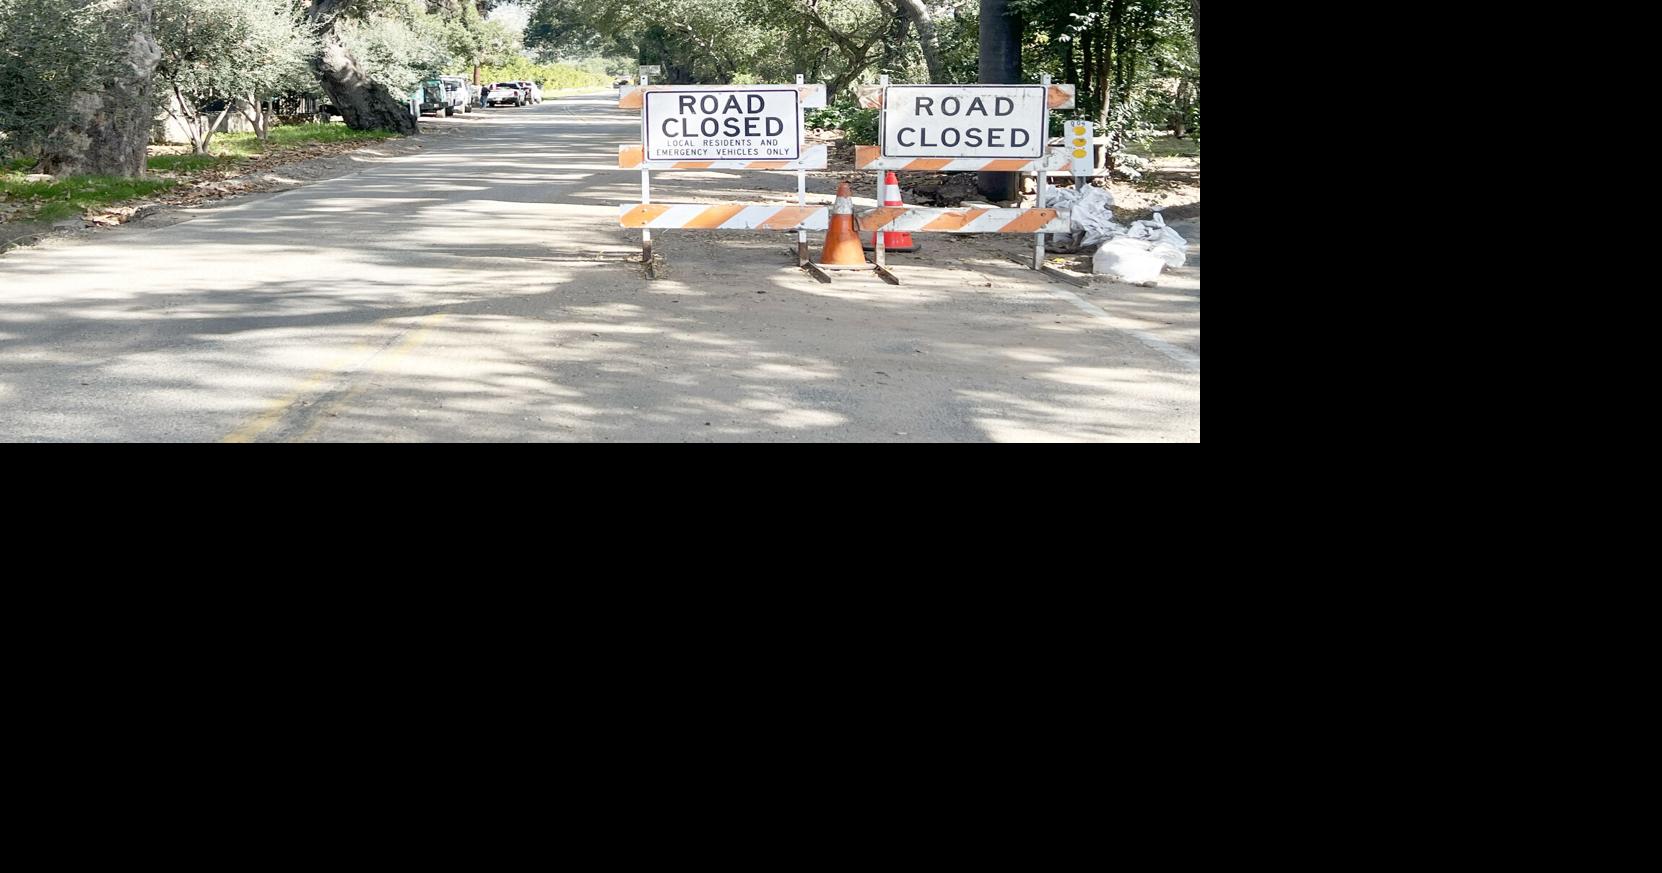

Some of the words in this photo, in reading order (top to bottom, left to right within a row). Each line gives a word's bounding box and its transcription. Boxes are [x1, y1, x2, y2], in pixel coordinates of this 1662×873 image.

[678, 94, 766, 115] ROAD
[914, 96, 1015, 117] ROAD
[661, 116, 784, 138] CLOSED
[896, 127, 1030, 148] CLOSED
[656, 148, 708, 156] EMERGENCY
[716, 148, 759, 156] VEHICLES
[766, 148, 790, 156] ONLY
[667, 139, 694, 147] LOCAL
[703, 139, 752, 147] RESIDENTS
[760, 139, 778, 147] AND
